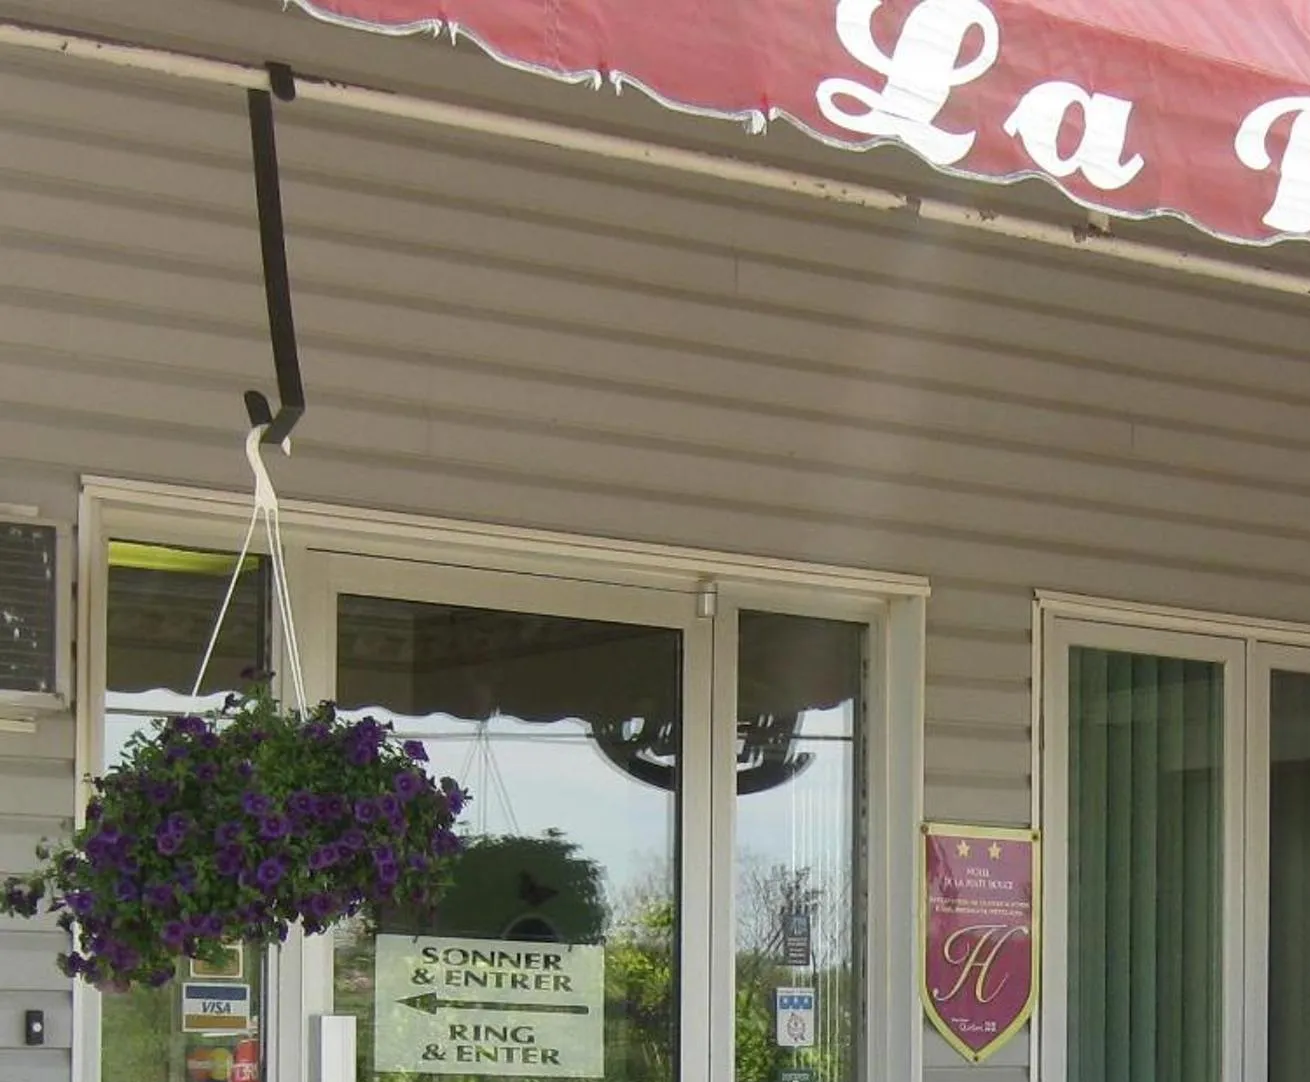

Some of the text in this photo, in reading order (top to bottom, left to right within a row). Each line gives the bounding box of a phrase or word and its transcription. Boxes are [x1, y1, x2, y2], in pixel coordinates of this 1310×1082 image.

[814, 0, 1146, 190] La
[421, 946, 562, 971] SONNER
[411, 968, 574, 992] & ENTRER
[202, 1002, 232, 1014] VISA
[449, 1023, 535, 1044] RING
[421, 1044, 561, 1066] & ENTER
